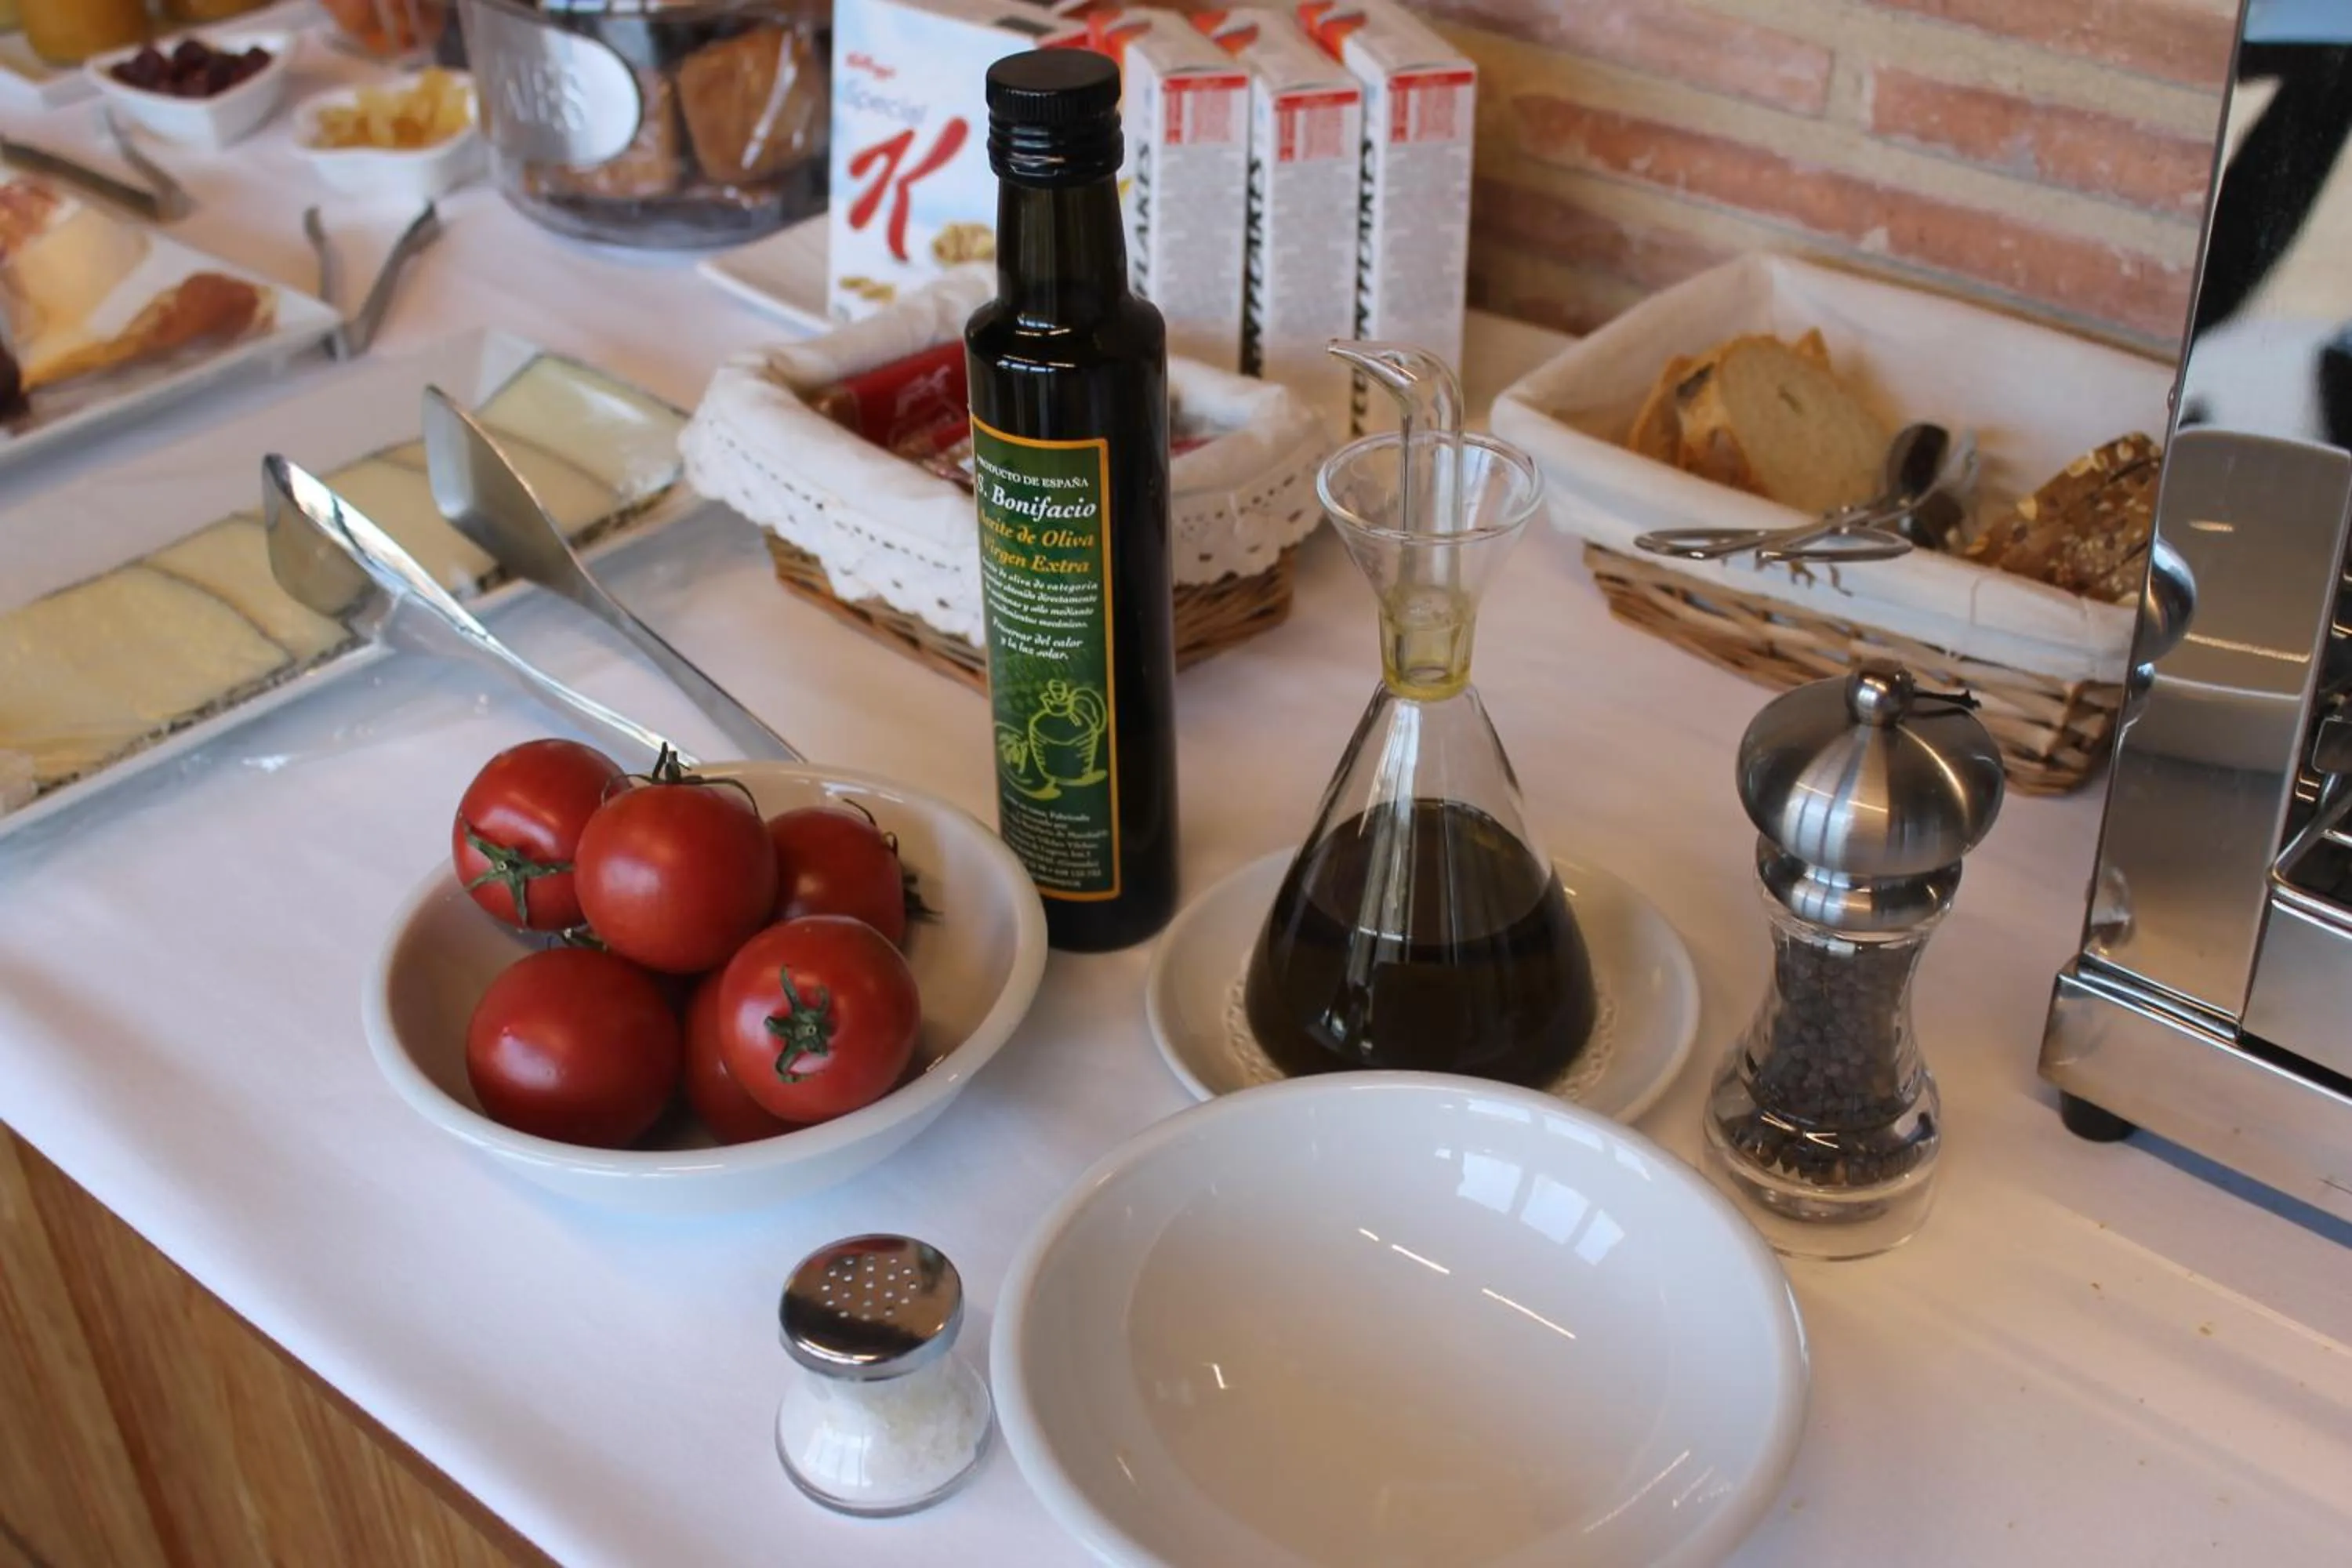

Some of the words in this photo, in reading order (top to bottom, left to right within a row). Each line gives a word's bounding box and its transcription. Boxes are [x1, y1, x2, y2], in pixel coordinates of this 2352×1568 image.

[848, 117, 969, 263] K
[977, 453, 1022, 484] PRODUCTO
[1023, 475, 1040, 487] DE
[1042, 476, 1090, 488] ESPAÑA
[991, 483, 1097, 522] Bonifacio
[984, 534, 1027, 567] Virgen
[1031, 554, 1091, 573] Extra
[1017, 524, 1036, 545] de
[1041, 528, 1095, 548] Oliva
[1034, 633, 1051, 647] del
